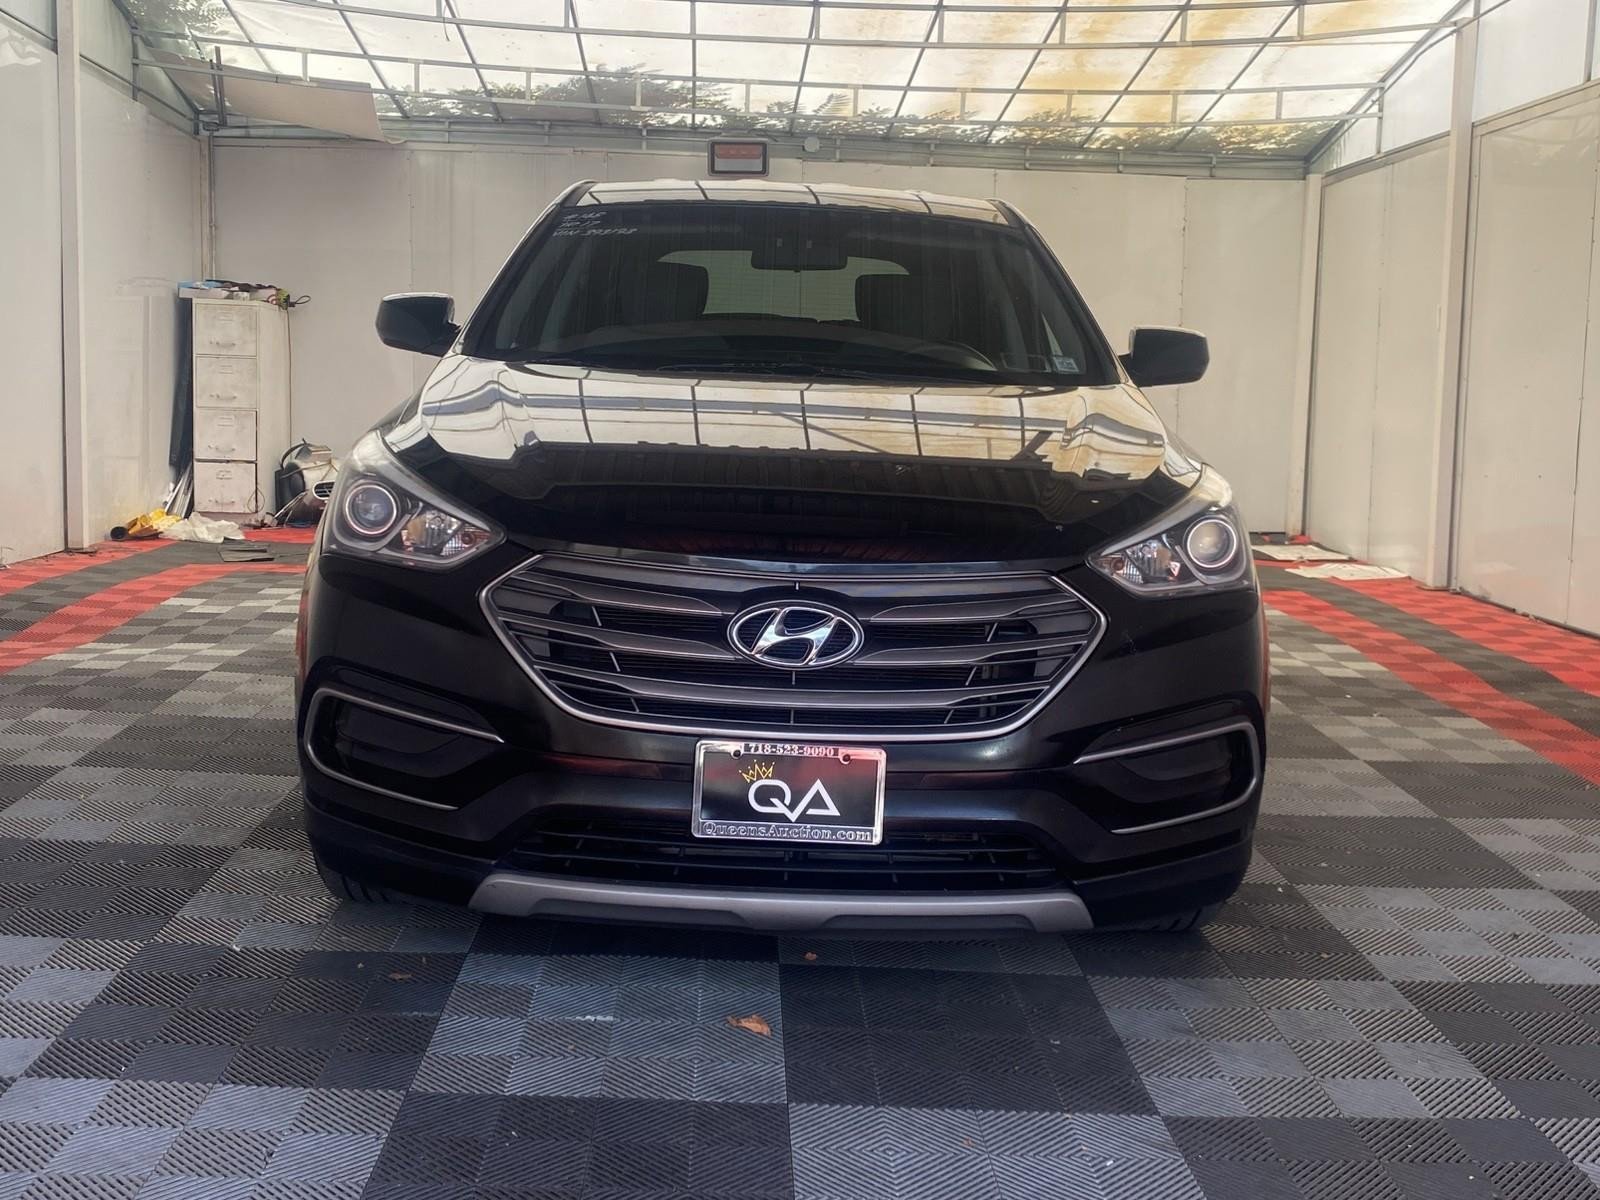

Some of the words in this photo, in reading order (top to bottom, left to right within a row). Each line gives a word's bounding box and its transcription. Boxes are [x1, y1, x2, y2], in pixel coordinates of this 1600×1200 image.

[750, 743, 835, 757] 718-523-9090
[748, 778, 841, 823] QA
[702, 821, 872, 841] QueensAuction.com
